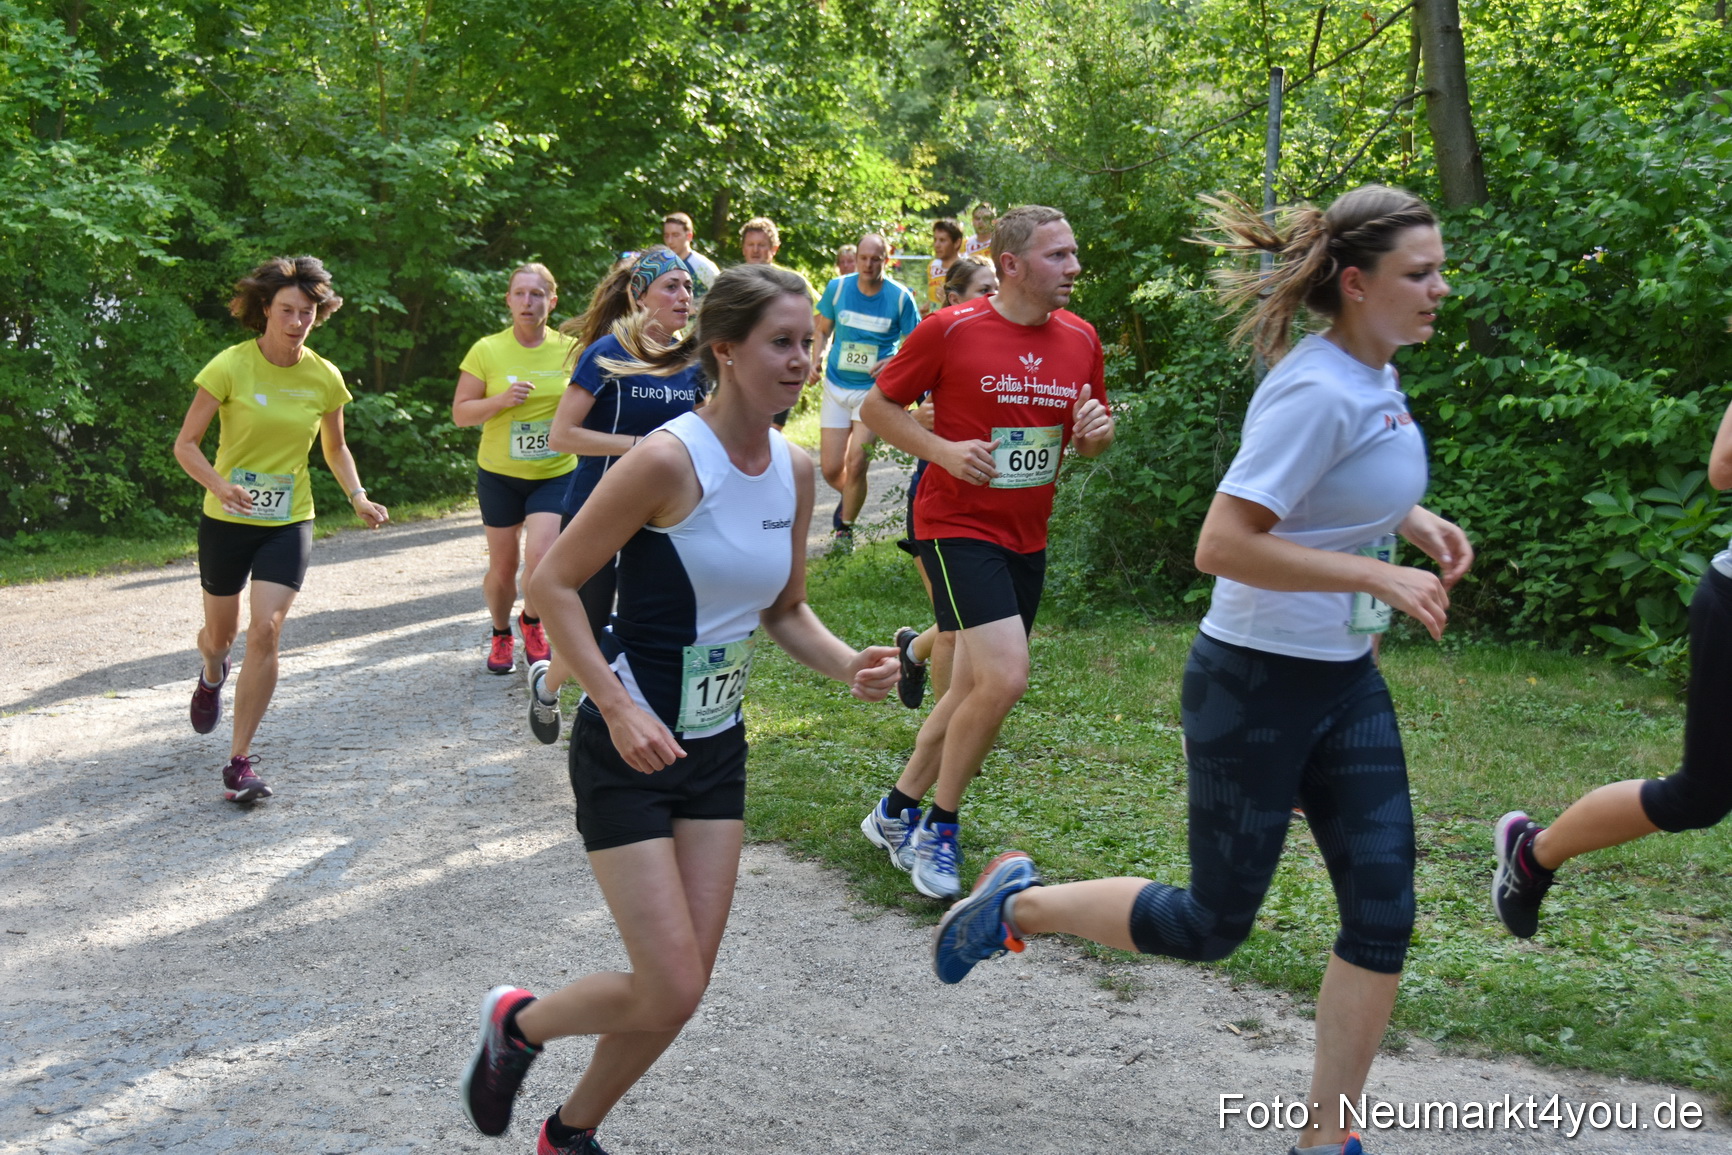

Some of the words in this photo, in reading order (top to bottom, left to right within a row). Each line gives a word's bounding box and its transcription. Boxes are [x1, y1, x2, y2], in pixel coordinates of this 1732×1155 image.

[846, 352, 868, 365] 829
[631, 385, 664, 399] EURO
[980, 374, 1023, 393] Echtes
[997, 394, 1029, 405] IMMER
[1032, 396, 1068, 409] FRISCH
[1009, 449, 1049, 472] 609
[243, 487, 285, 508] 237
